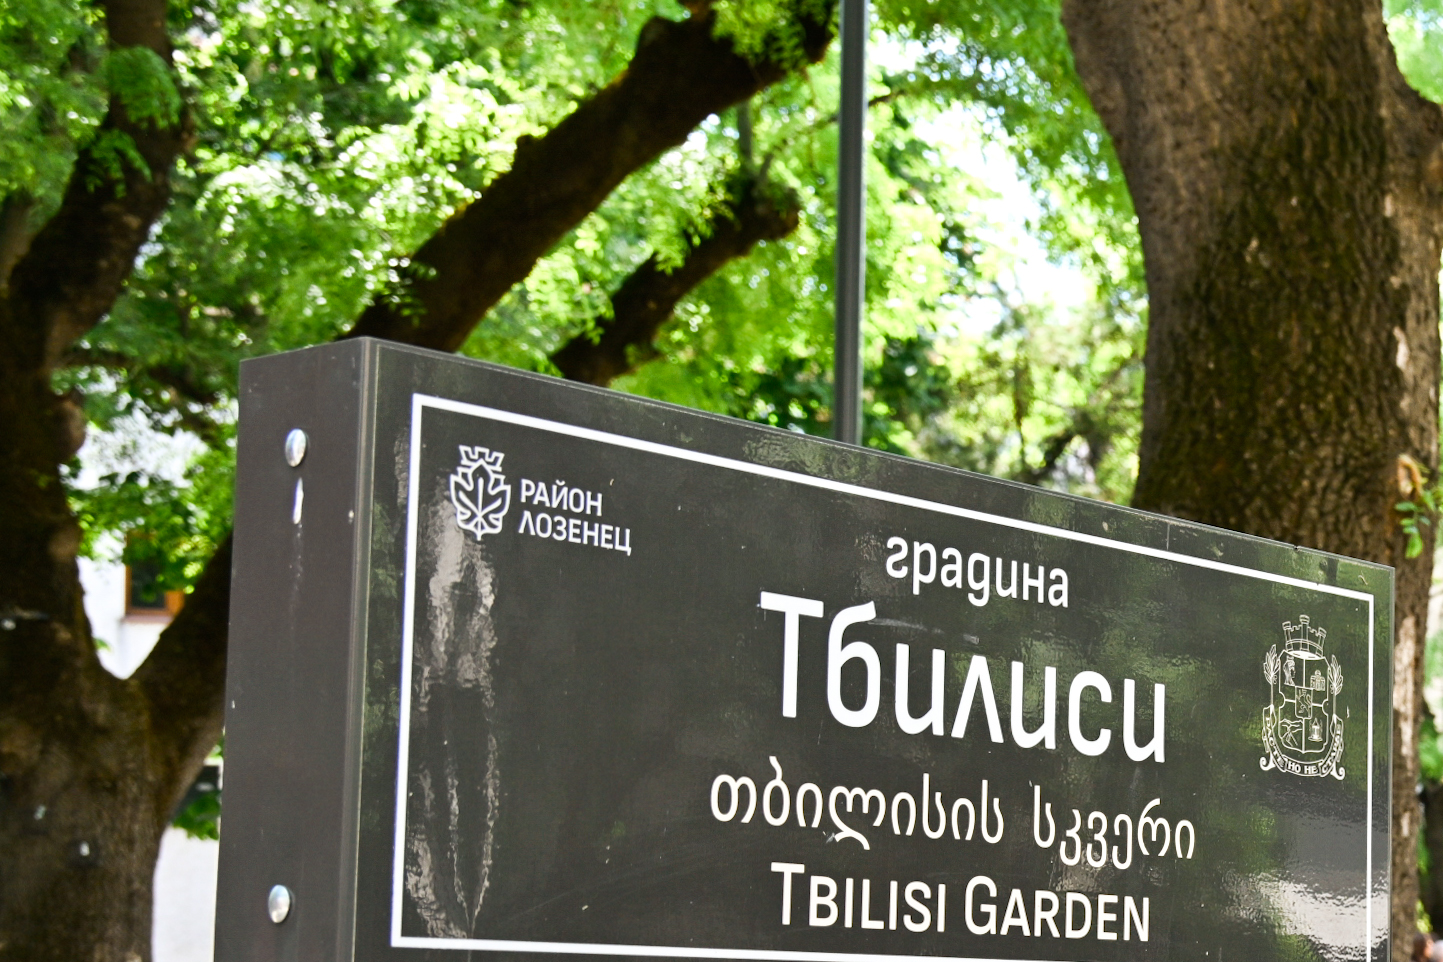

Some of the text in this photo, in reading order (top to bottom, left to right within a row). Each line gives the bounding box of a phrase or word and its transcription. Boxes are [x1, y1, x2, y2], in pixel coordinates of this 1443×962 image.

[518, 510, 632, 557] ЛОЗЕНЕЦ
[520, 478, 603, 517] РАЙОН
[885, 536, 1069, 608] градина
[757, 590, 1166, 764] Тбилиси
[1287, 761, 1301, 773] НО
[1303, 765, 1318, 775] НЕ
[710, 755, 1195, 871] თბილისის სკვერი
[770, 861, 1150, 942] TBILISI GARDEN
